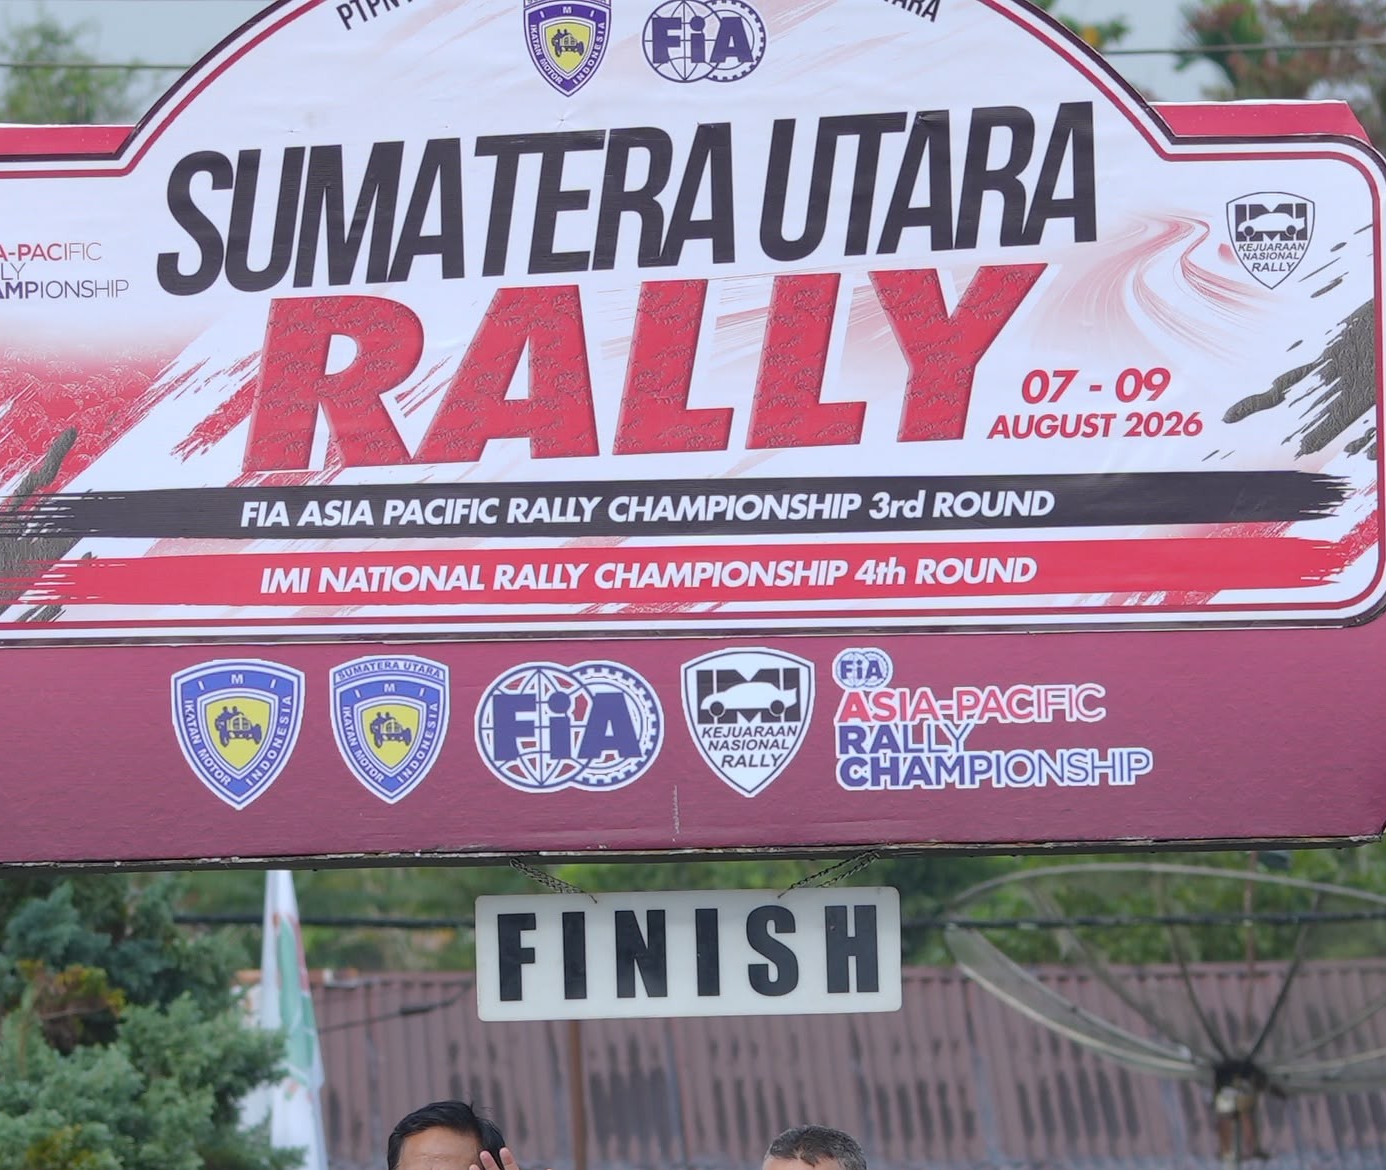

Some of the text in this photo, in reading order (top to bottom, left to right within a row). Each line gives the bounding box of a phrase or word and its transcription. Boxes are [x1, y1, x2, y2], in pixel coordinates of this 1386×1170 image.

[156, 101, 1098, 296] SUMATERA UTARA
[1238, 241, 1307, 253] KEJUARAAN
[1242, 250, 1301, 262] NASIONAL
[1252, 261, 1298, 275] RALLY
[241, 262, 1048, 474] RALLY
[1021, 370, 1072, 405] 07
[1114, 368, 1171, 403] 09
[987, 411, 1204, 441] AUGUST 2026
[241, 490, 1056, 529] FIA ASIA PACIFIC RALLY CHAMPIONSHIP 3rd ROUND
[260, 556, 1038, 595] IMI NATIONAL RALLY CHAMPIONSHIP 4th ROUND
[338, 661, 441, 680] SUMATERA UTARA
[836, 686, 1107, 723] ASIA-PACIFIC
[184, 695, 293, 787] IKATAN MOTOR INDONESIA
[342, 702, 439, 784] IKATAN MOTOR INDONESIA
[701, 724, 799, 740] KEJUARAAN
[707, 737, 791, 752] NASIONAL
[838, 721, 974, 756] RALLY
[720, 752, 783, 769] RALLY
[837, 750, 1152, 787] CHAMPIONSHIP
[497, 904, 880, 1002] FINISH
